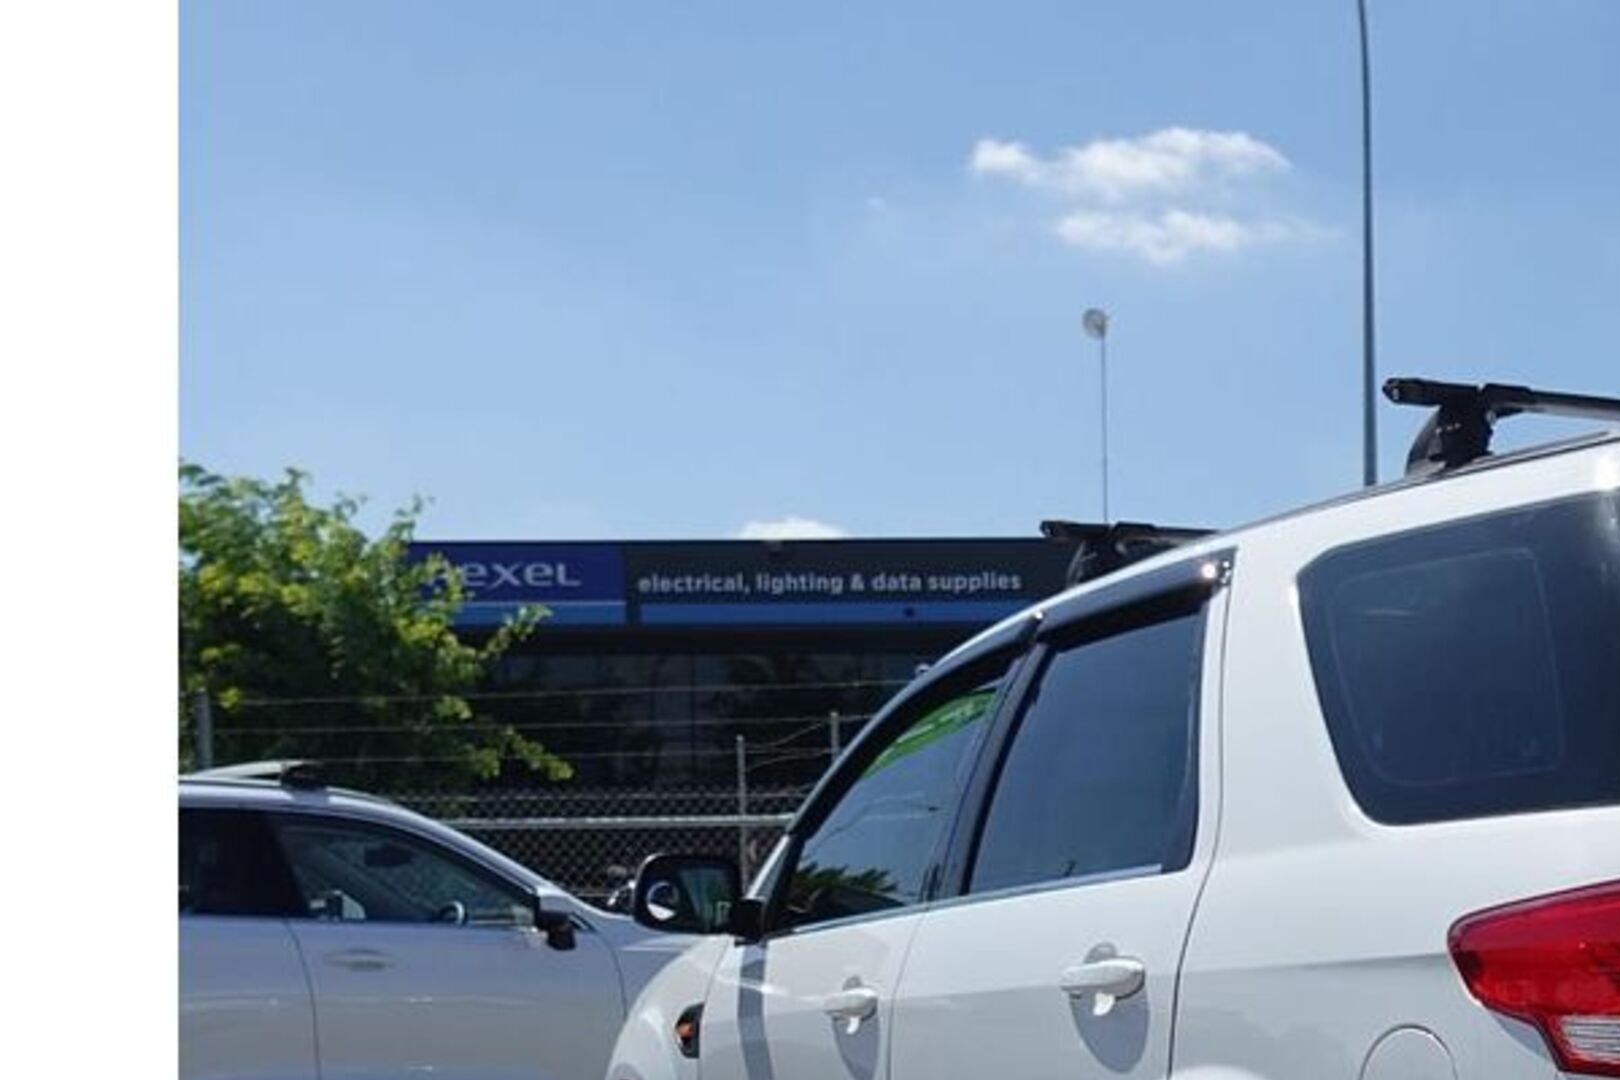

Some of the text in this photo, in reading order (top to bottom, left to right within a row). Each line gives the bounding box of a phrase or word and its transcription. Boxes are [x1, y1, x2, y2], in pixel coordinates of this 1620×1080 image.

[638, 571, 1022, 595] electrical, lighting & data supplies
